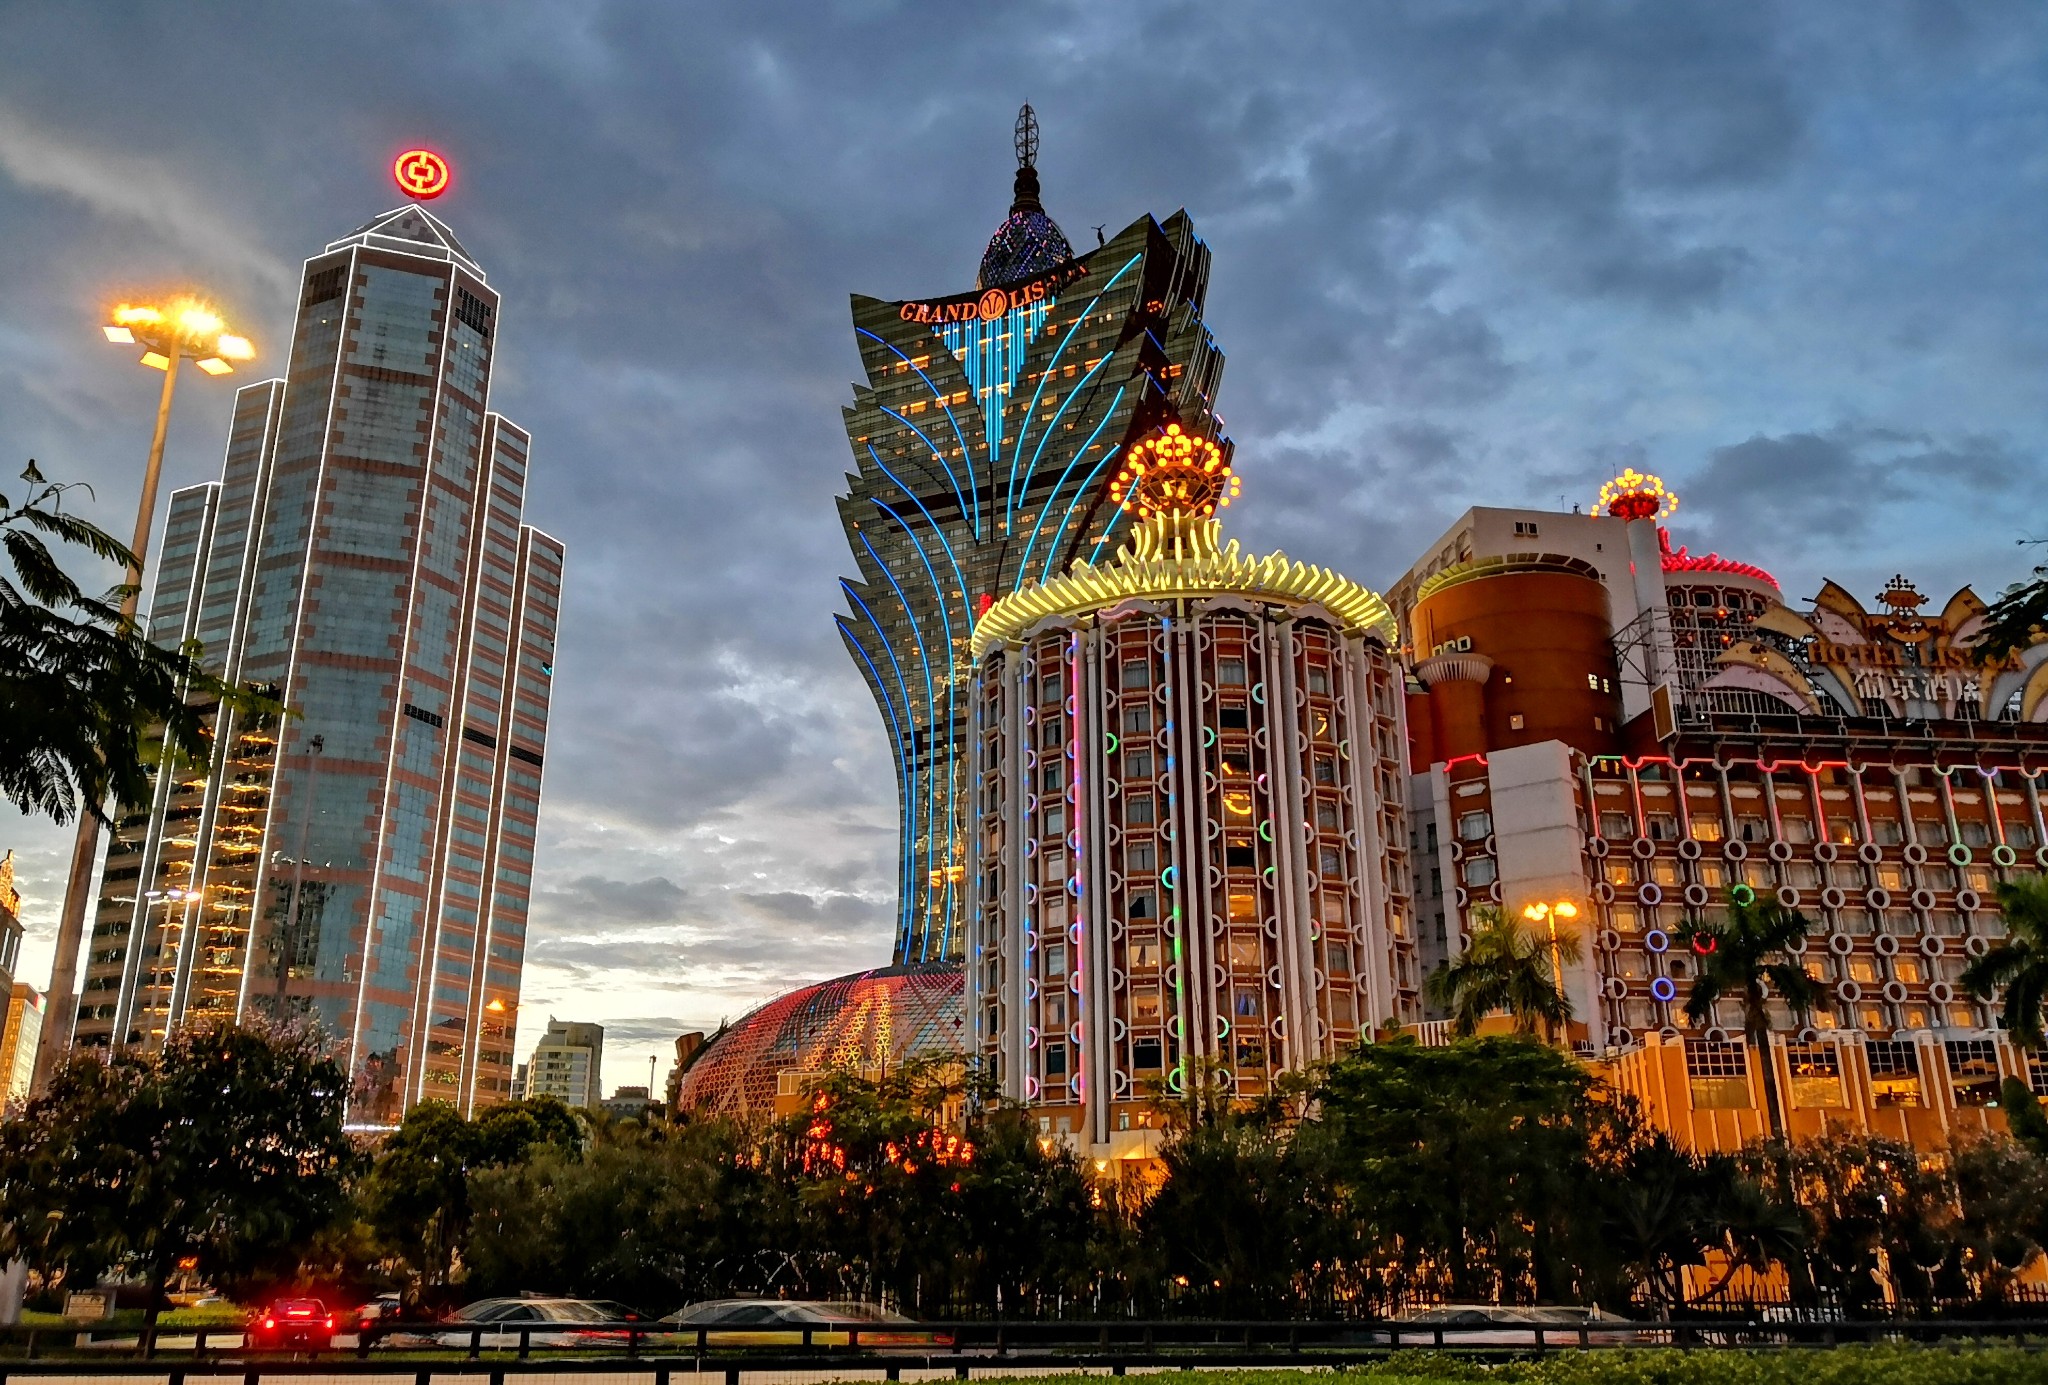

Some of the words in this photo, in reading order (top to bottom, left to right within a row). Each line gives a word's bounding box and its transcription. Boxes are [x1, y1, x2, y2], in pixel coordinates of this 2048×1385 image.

[900, 302, 978, 324] GRAND
[1009, 265, 1090, 309] LIS
[1807, 642, 1911, 667] HOTEL
[1919, 643, 2027, 671] LISA
